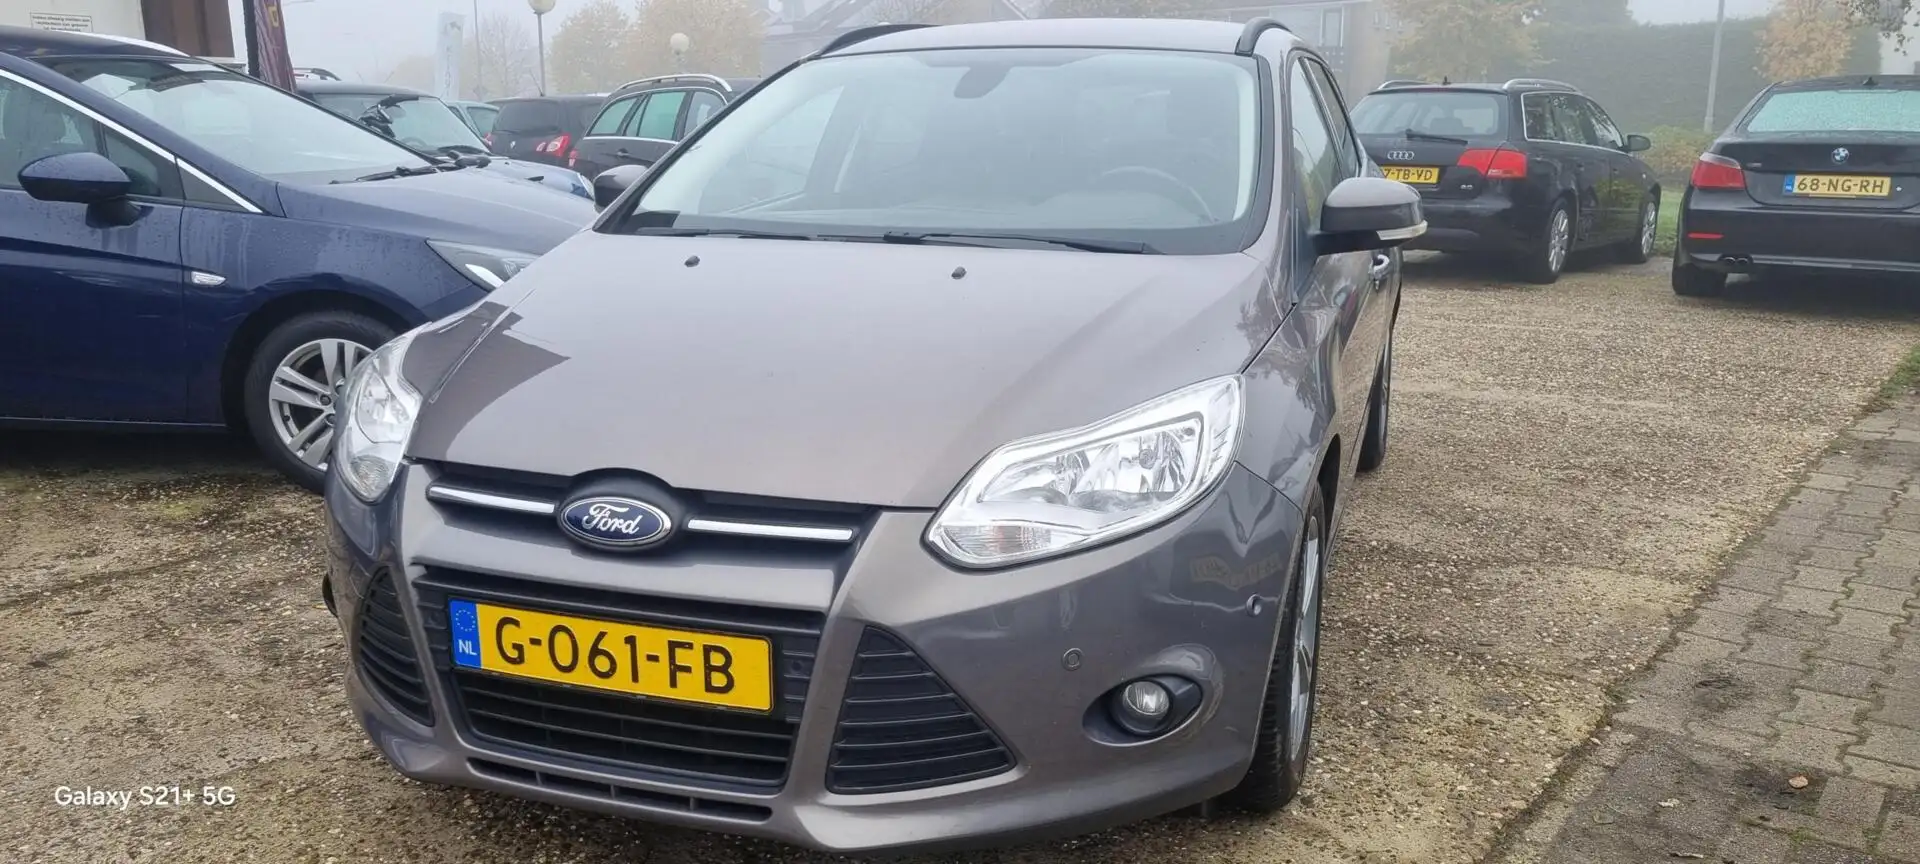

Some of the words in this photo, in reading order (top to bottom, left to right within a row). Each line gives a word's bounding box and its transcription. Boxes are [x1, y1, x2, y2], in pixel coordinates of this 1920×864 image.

[1383, 168, 1433, 181] 7-TB-VD
[1797, 177, 1884, 193] 68-NG-RH
[582, 503, 643, 535] Ford
[457, 638, 478, 656] NL
[495, 615, 736, 695] G-061-FB
